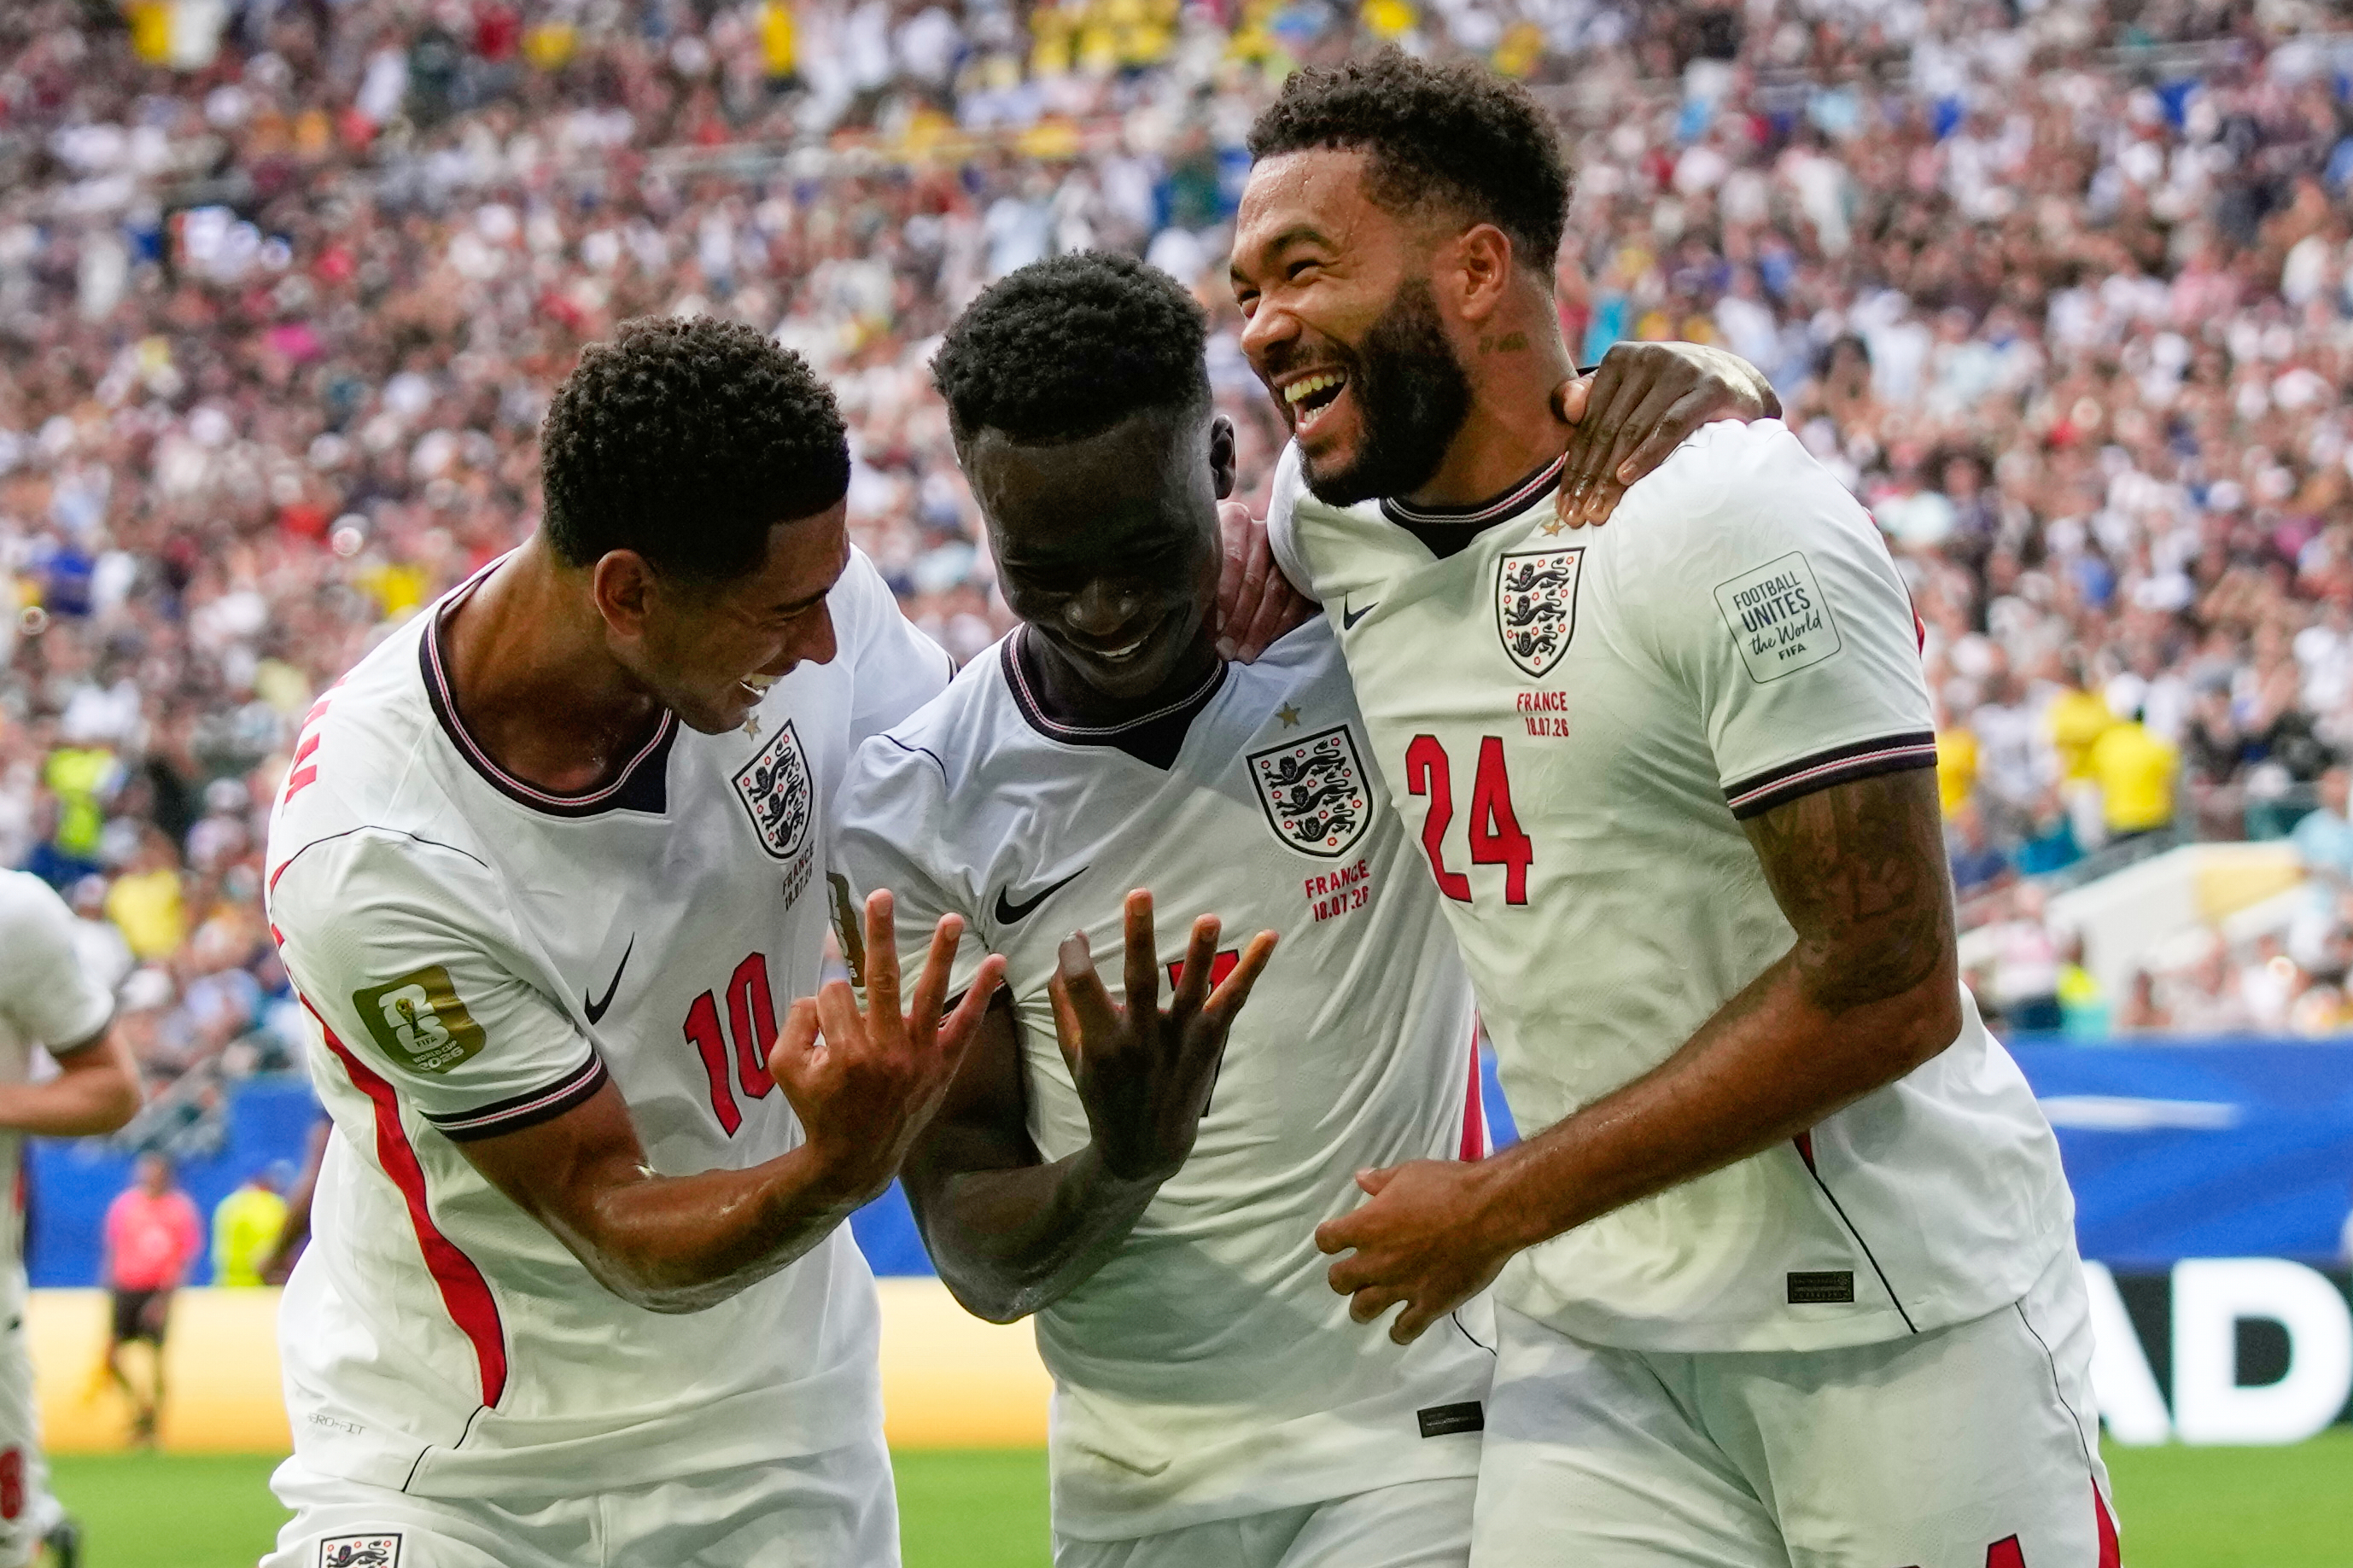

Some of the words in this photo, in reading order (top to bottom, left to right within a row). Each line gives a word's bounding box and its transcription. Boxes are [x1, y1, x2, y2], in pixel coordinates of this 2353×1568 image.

[1732, 570, 1801, 611] FOOTBALL
[1740, 586, 1811, 633] UNITES
[1748, 633, 1777, 656] the
[1775, 609, 1824, 645] World
[1778, 643, 1807, 661] FIFA
[1516, 691, 1568, 713] FRANCE
[1525, 716, 1569, 737] 18.07.26
[1405, 733, 1533, 906] 24
[1304, 859, 1370, 899] FRANCE
[412, 1049, 442, 1064] WORLD
[441, 1040, 458, 1053] CUP
[416, 1036, 438, 1047] FIFA
[683, 951, 779, 1140] 10
